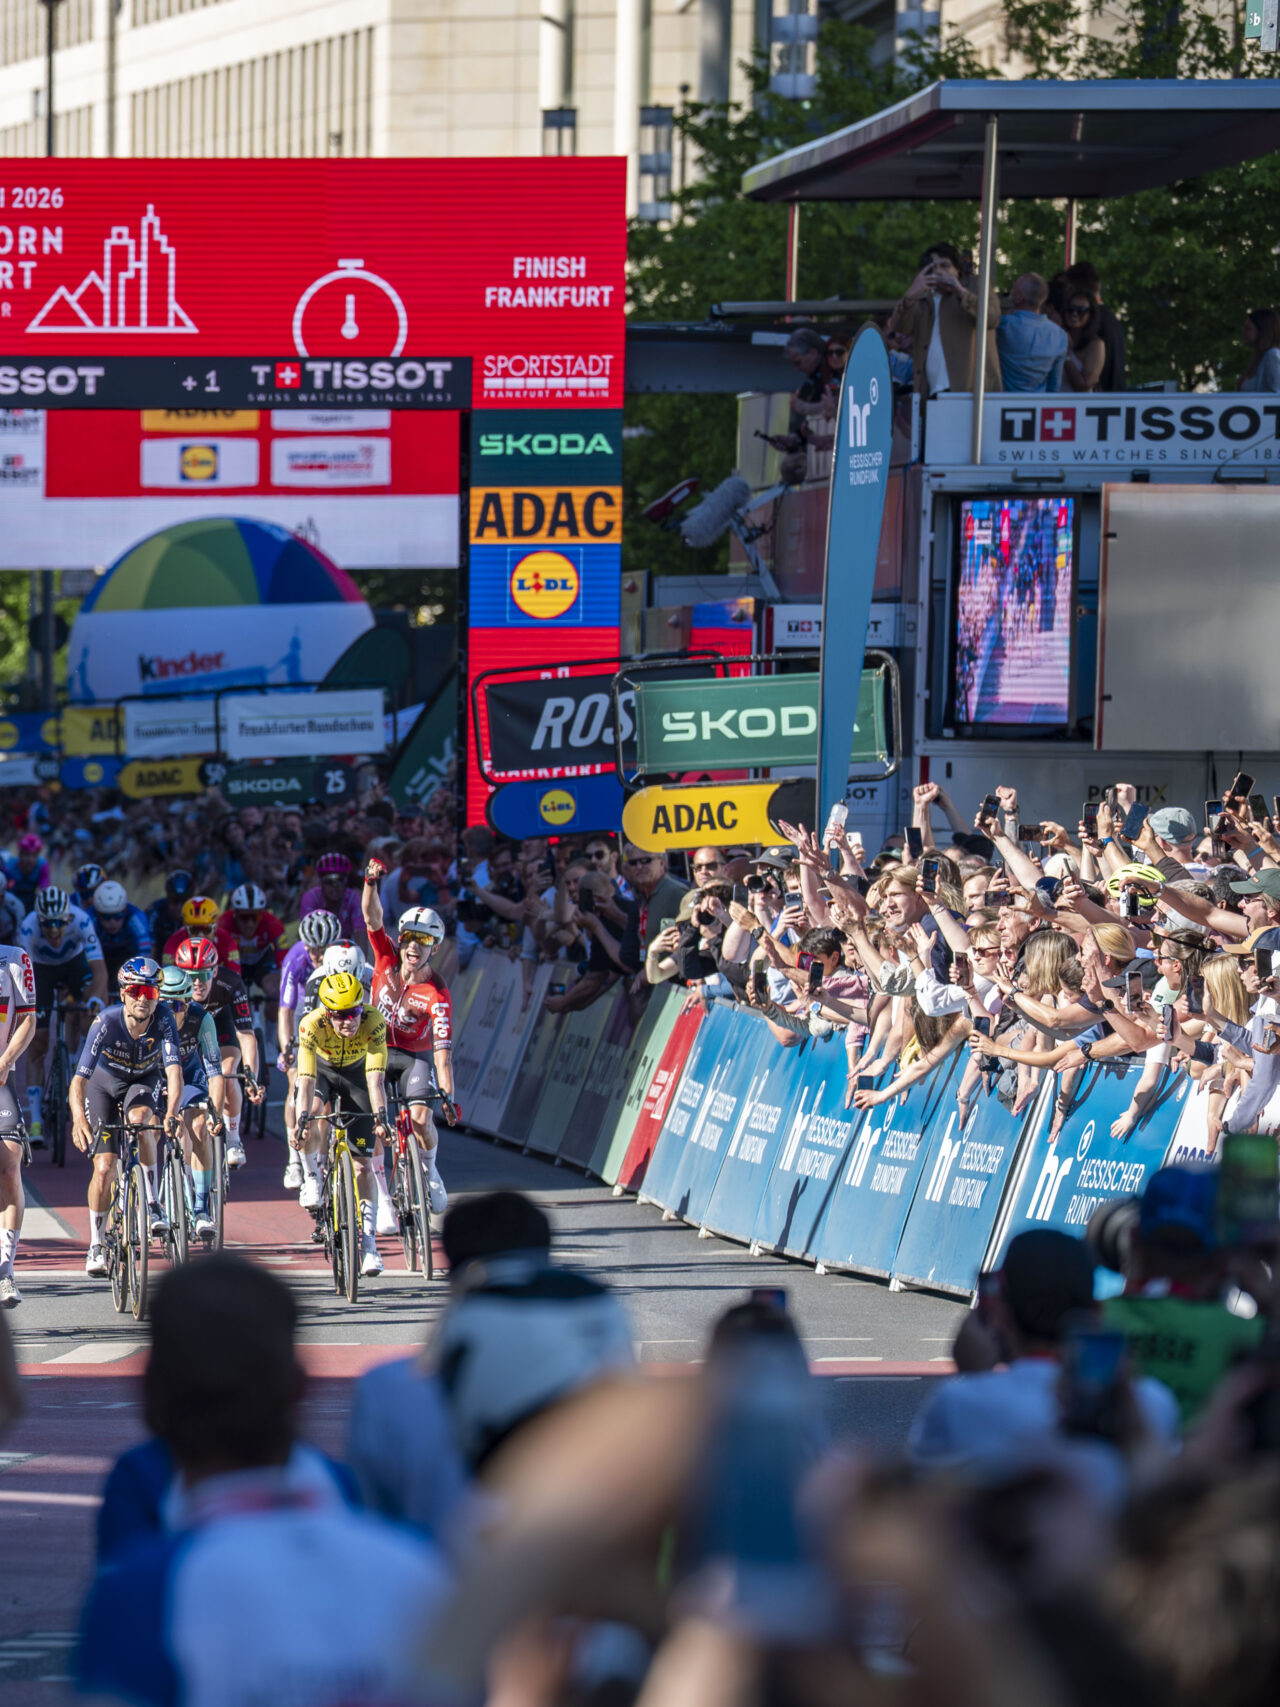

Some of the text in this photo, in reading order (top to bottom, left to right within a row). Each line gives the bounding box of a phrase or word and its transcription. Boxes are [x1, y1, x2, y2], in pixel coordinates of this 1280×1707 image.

[11, 187, 64, 209] 2026
[513, 256, 587, 279] FINISH
[485, 286, 615, 308] FRANKFURT
[305, 361, 453, 389] TISSOT
[483, 354, 615, 377] SPORTSTADT
[248, 393, 291, 402] SWISS
[298, 393, 364, 402] WATCHES
[371, 393, 413, 402] SINCE
[483, 389, 609, 398] FRANKFURT AM MAIN
[848, 385, 871, 448] hr
[998, 450, 1060, 462] SWISS
[1073, 450, 1168, 461] WATCHES
[1180, 449, 1241, 461] SINCE
[475, 491, 616, 538] ADAC
[530, 693, 639, 751] ROS
[662, 705, 860, 743] SKOD
[325, 769, 346, 794] 25
[651, 800, 738, 834] ADAC
[805, 1114, 852, 1148] HESSISCHER
[881, 1129, 921, 1160] HESSISCHER
[796, 1147, 836, 1181] RUNDFUNK
[925, 1111, 962, 1202] hr
[959, 1142, 1005, 1174] HESSISCHER
[870, 1163, 908, 1195] RUNDFUNK
[1026, 1132, 1073, 1221] hr
[1077, 1158, 1145, 1193] HESSISCHER
[948, 1176, 988, 1208] RUNDFUNK
